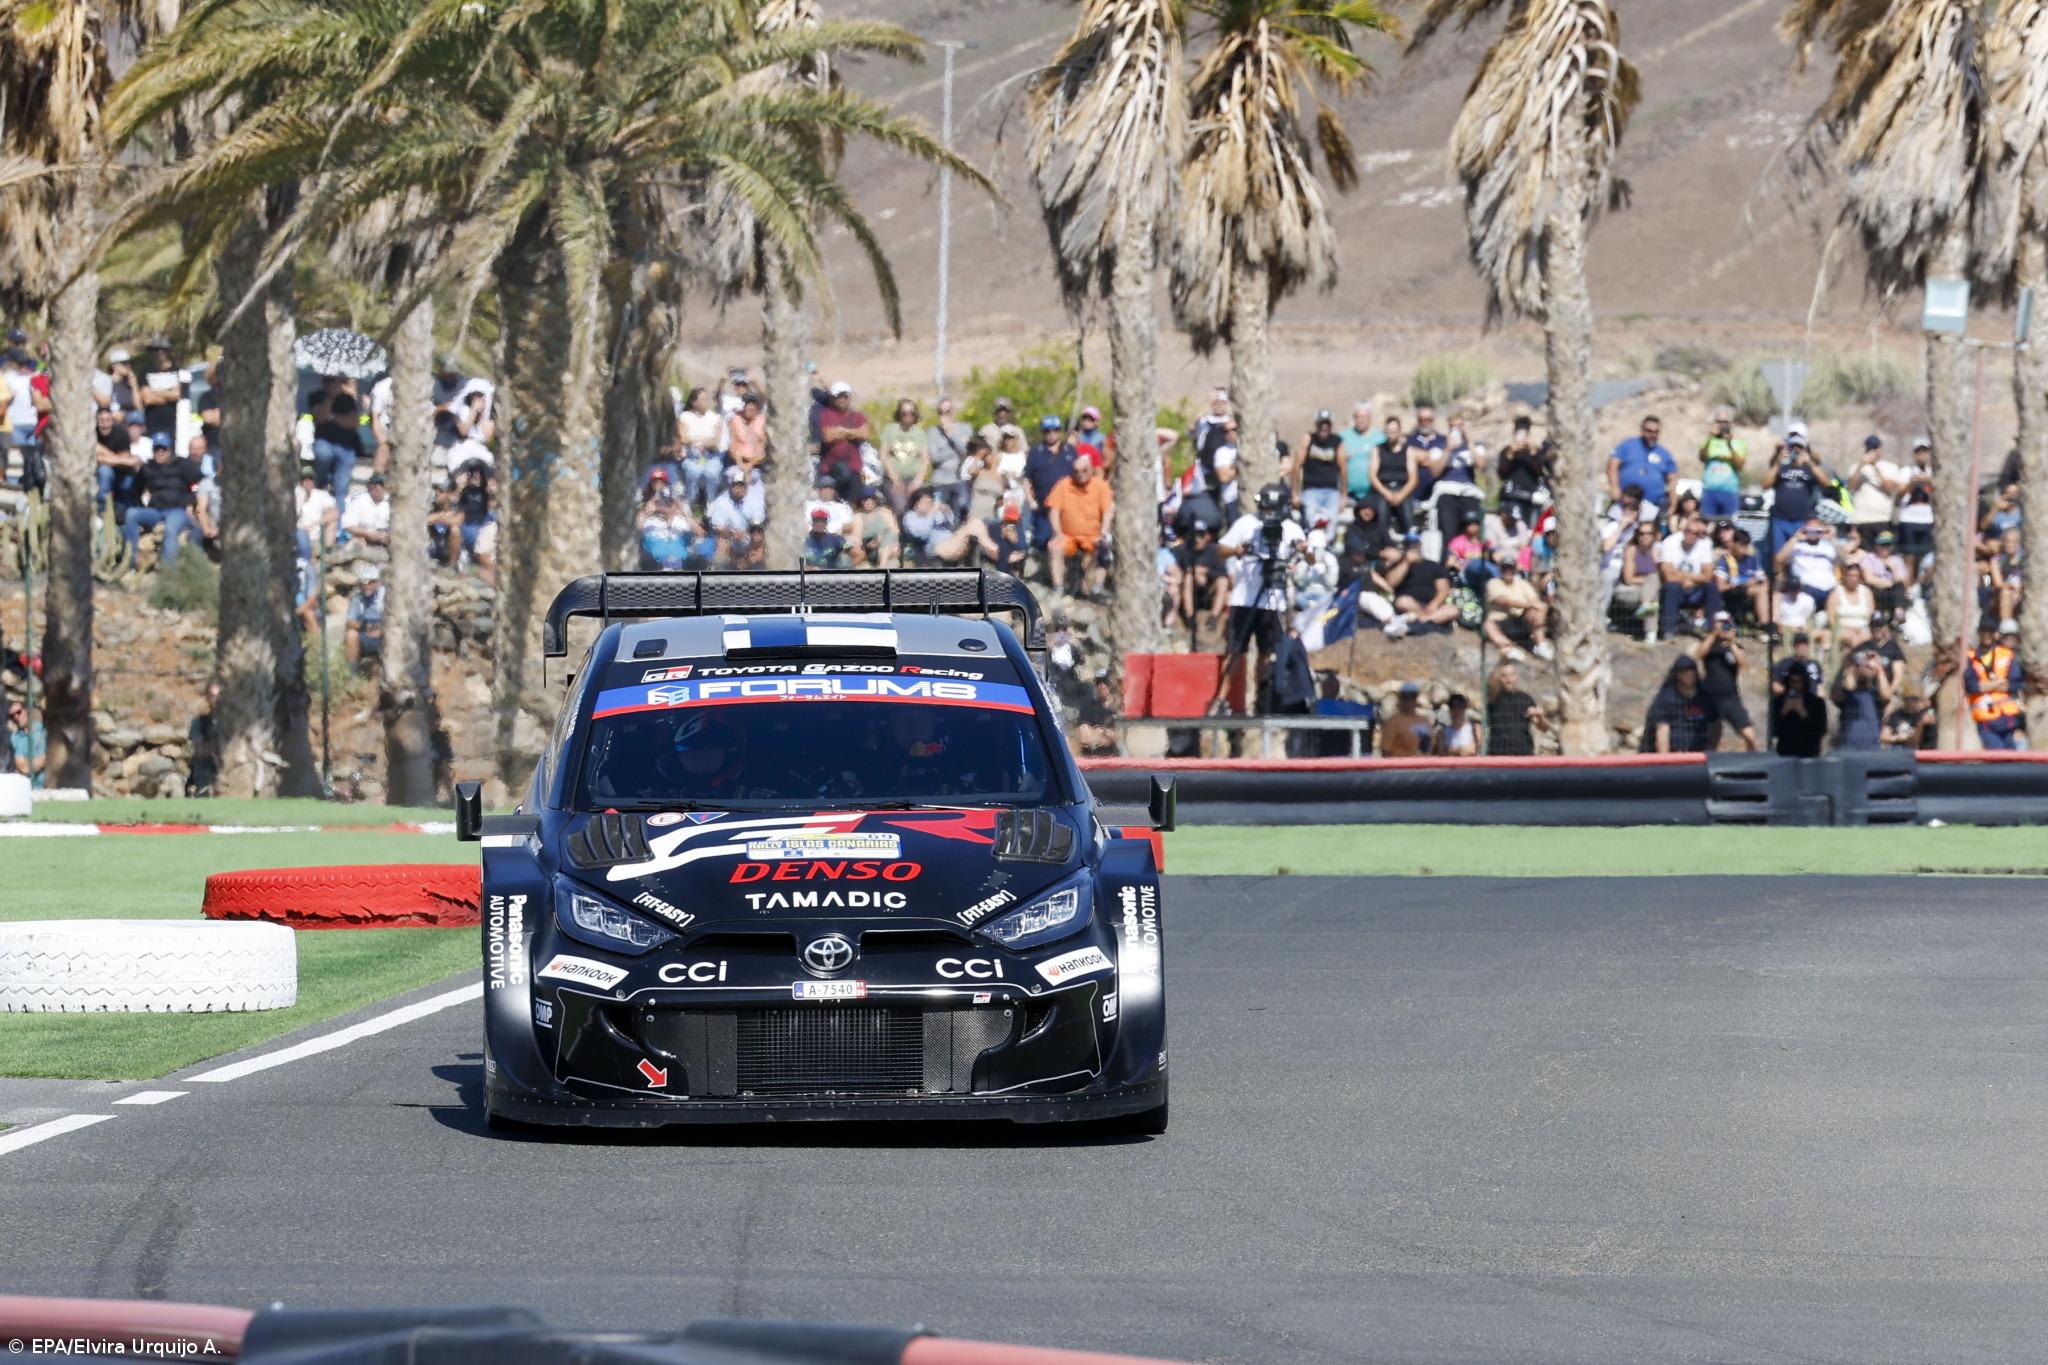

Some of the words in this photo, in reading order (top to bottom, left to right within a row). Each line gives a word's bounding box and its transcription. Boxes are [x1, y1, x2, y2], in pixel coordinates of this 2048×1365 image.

[698, 665, 797, 677] TOYOTA
[801, 663, 895, 676] GAZOO
[900, 665, 984, 681] Racing
[699, 678, 977, 700] FORUM8
[785, 839, 826, 850] ISLAS
[828, 839, 900, 849] CANARIAS
[729, 861, 923, 884] DENSO
[745, 891, 907, 911] TAMADIC
[490, 894, 505, 990] AUTOMOTIVE
[508, 894, 528, 986] Panasonic
[809, 984, 853, 995] A-7540
